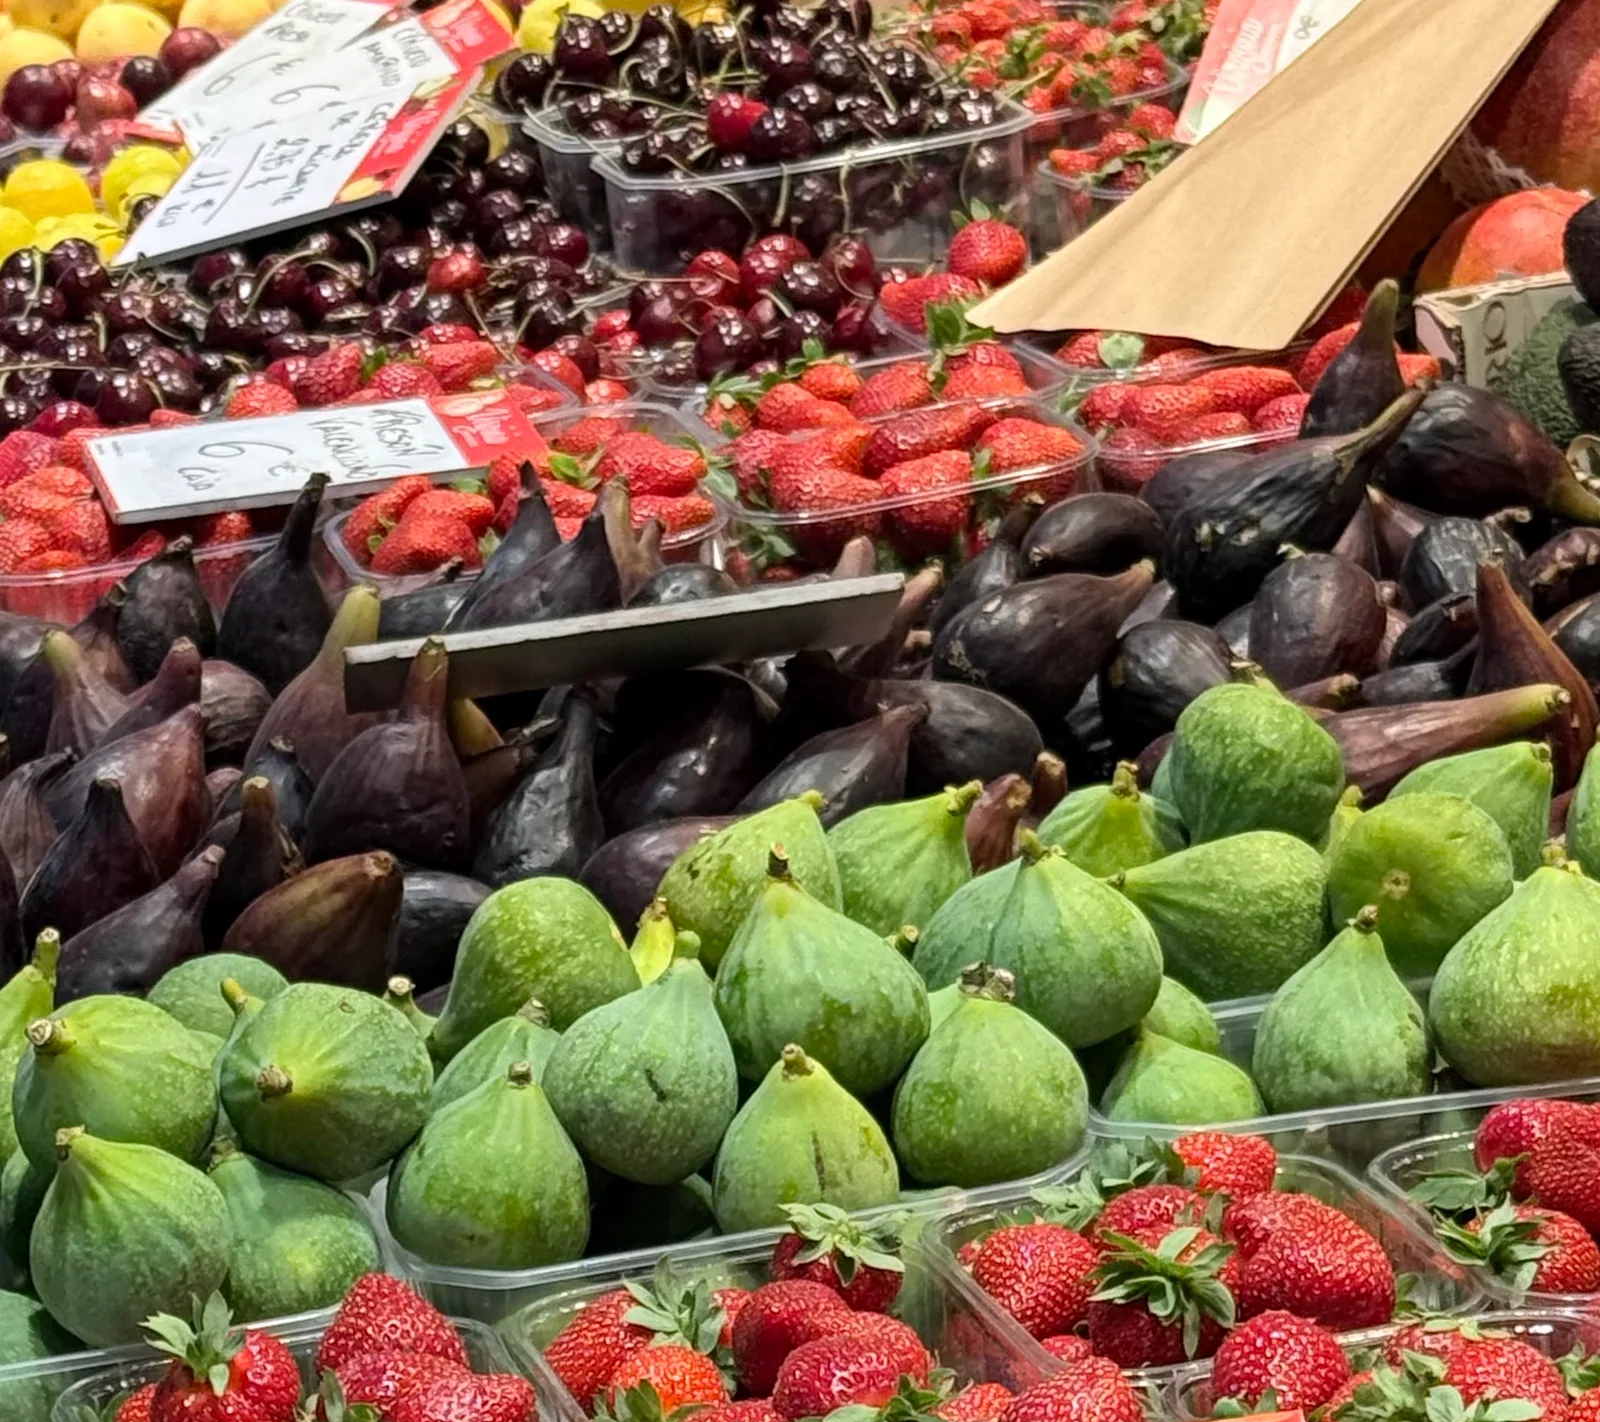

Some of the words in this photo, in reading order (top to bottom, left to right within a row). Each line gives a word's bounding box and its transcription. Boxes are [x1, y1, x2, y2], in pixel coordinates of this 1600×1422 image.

[203, 51, 282, 96] 6
[270, 84, 340, 105] 6
[199, 440, 295, 459] 6
